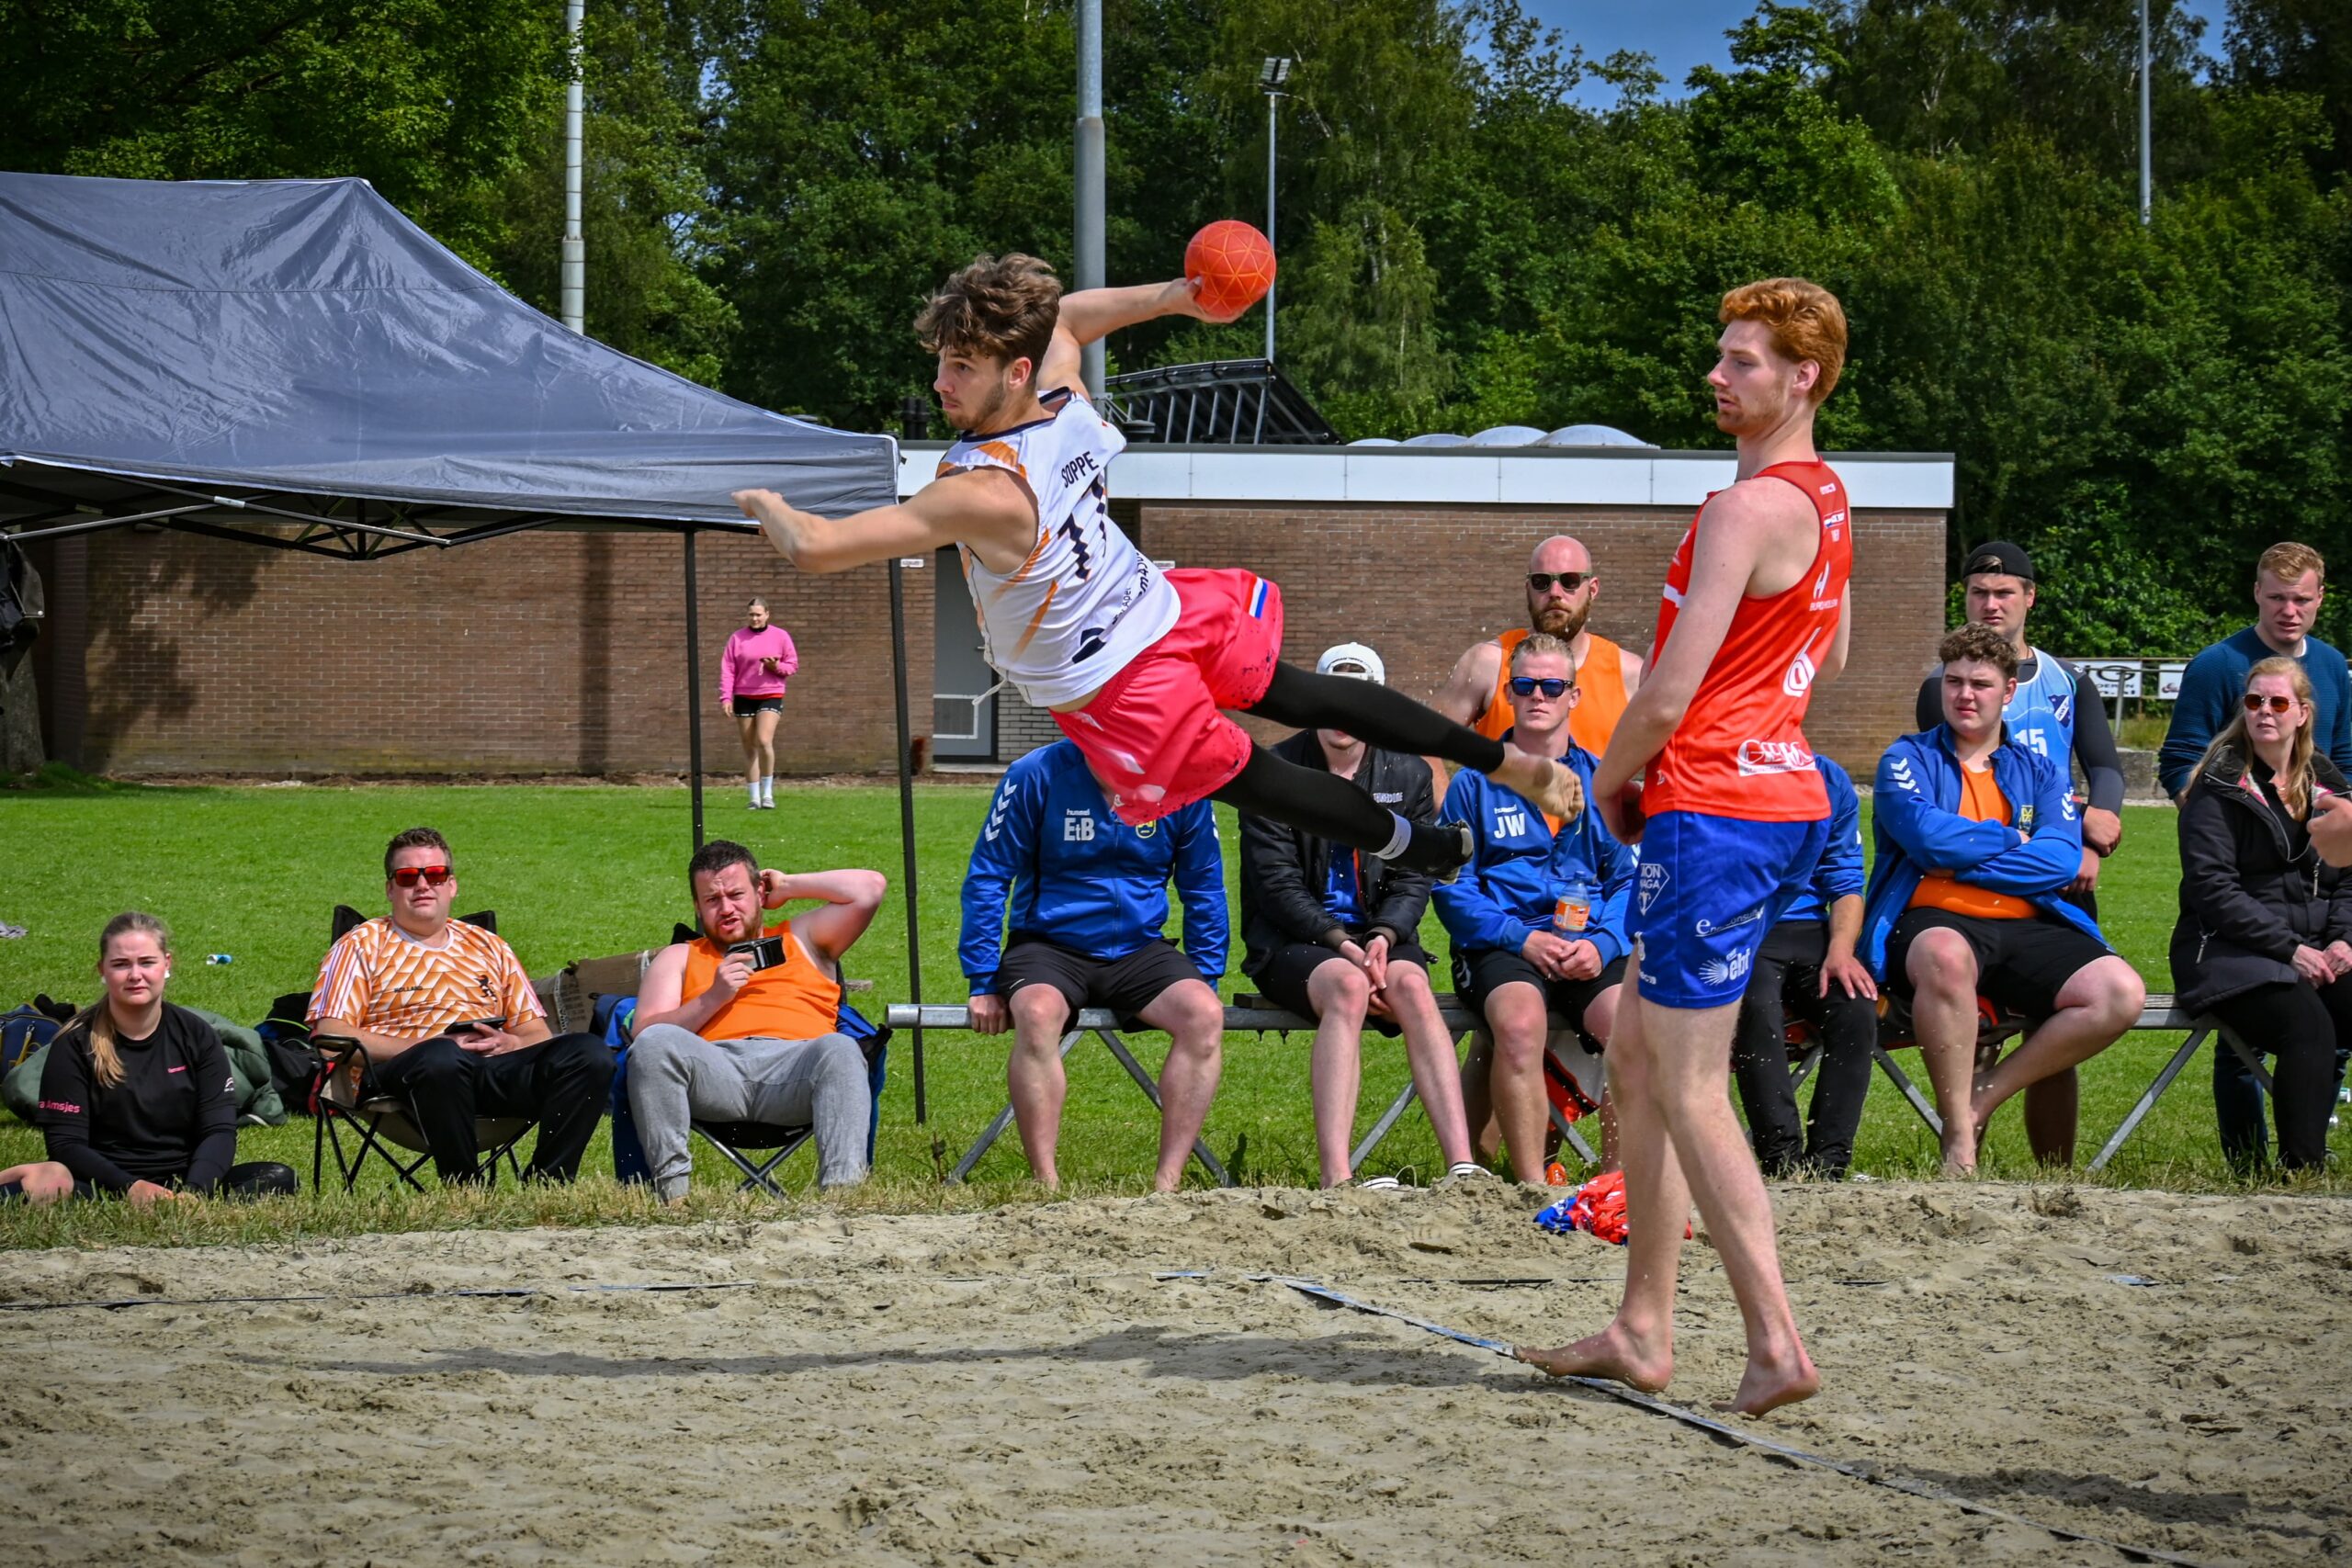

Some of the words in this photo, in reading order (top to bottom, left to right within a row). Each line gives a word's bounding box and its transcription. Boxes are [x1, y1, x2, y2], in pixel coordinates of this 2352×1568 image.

[1061, 450, 1100, 489] SOPPE
[1782, 626, 1822, 699] 6
[2014, 728, 2049, 758] 15
[1064, 817, 1096, 841] EtB
[1493, 812, 1526, 840] JW
